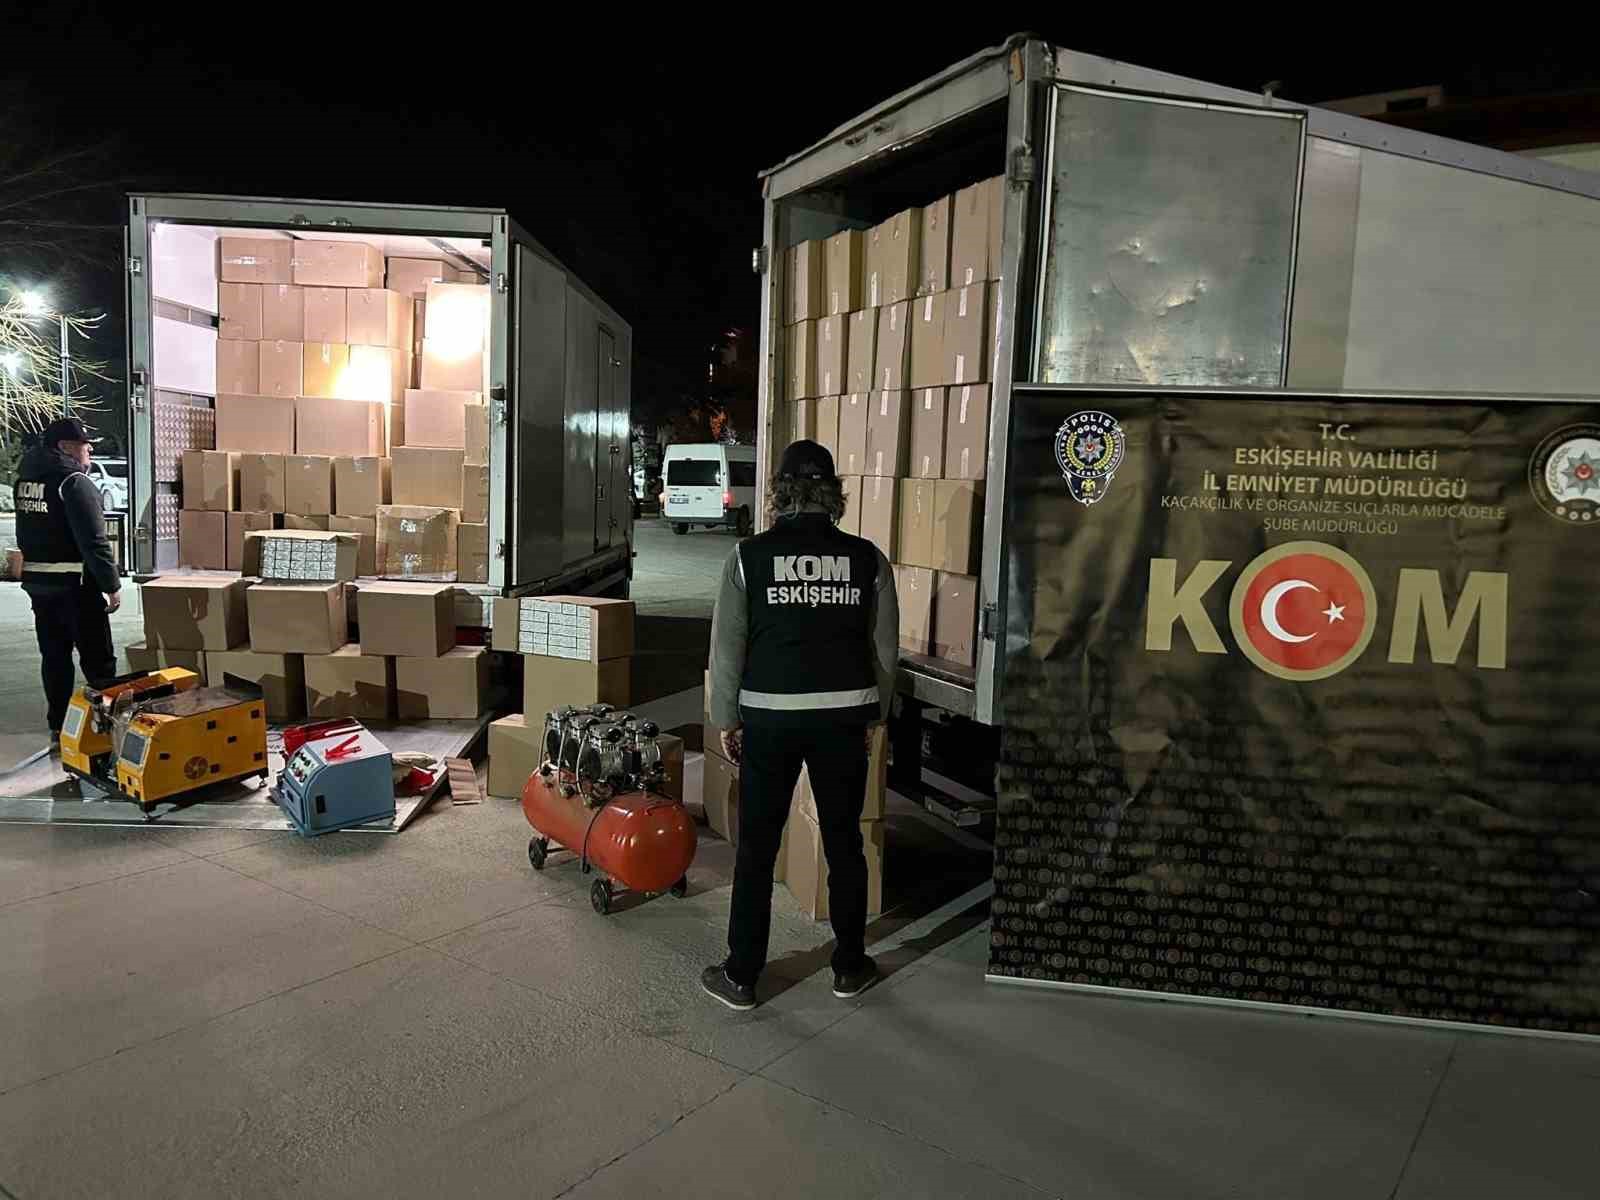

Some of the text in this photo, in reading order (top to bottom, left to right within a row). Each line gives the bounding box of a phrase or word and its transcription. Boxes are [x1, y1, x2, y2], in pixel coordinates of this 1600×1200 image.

[1319, 423, 1355, 441] T.C.
[1235, 445, 1438, 471] ESKİŞEHİR VALİLİĞİ
[1203, 470, 1467, 498] İL EMNİYET MÜDÜRLÜĞÜ
[1161, 495, 1243, 512] KAÇAKÇILIK
[1247, 498, 1264, 511] VE
[1344, 502, 1419, 517] SUÇLARLA
[1263, 518, 1398, 535] ŞUBE MÜDÜRLÜĞÜ
[773, 555, 850, 581] KOM
[767, 582, 861, 607] ESKİŞEHİR
